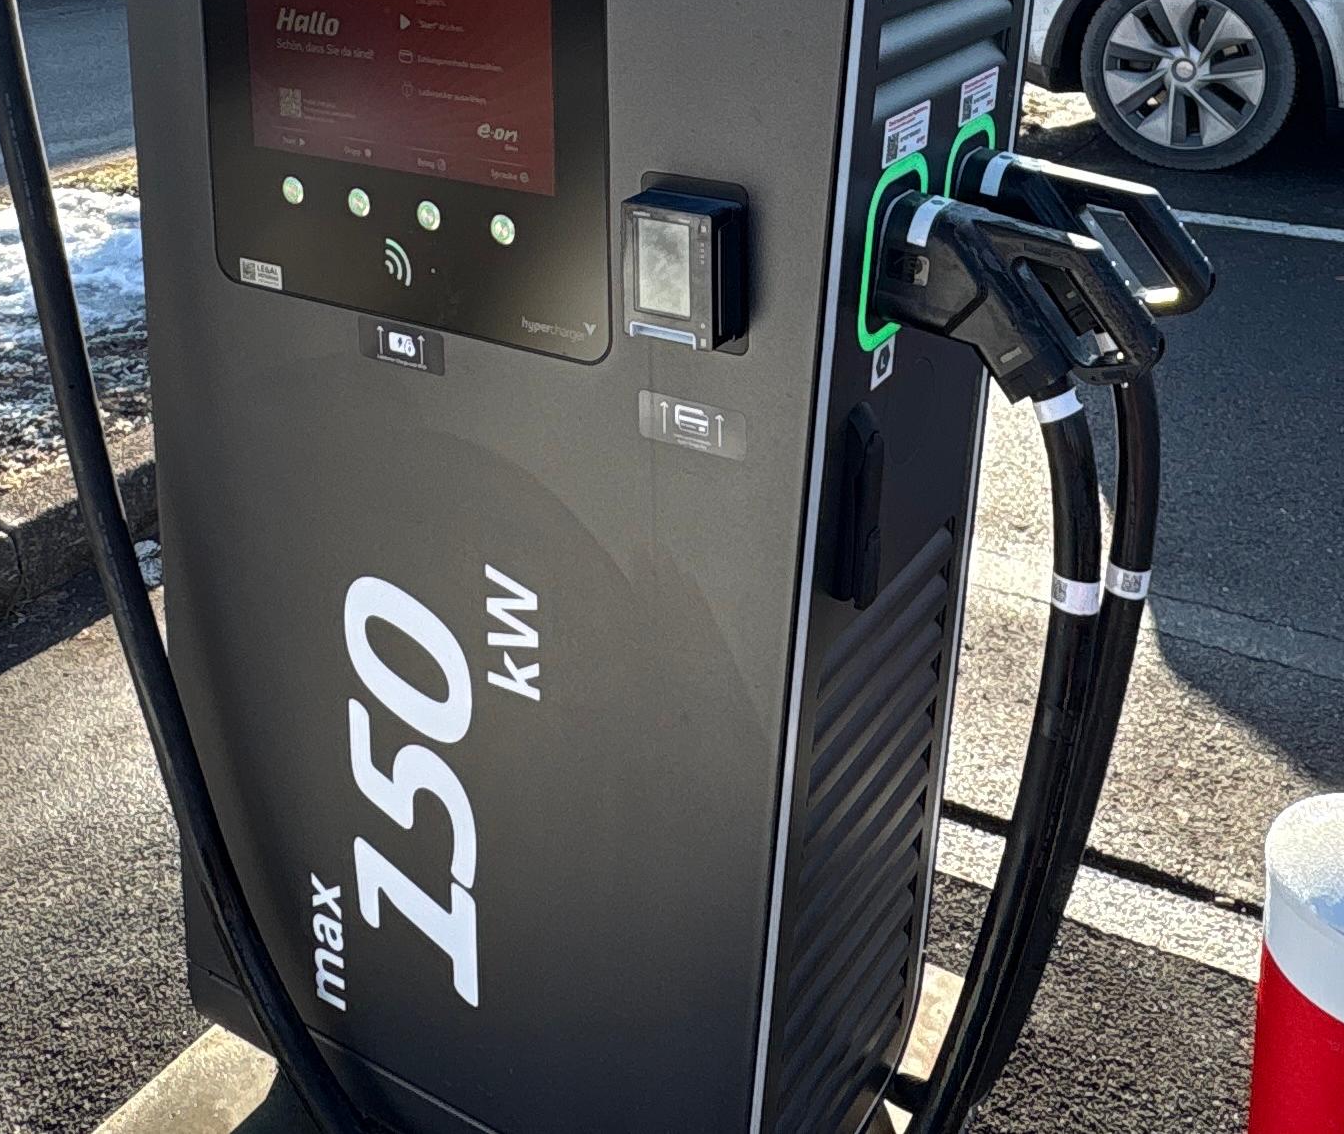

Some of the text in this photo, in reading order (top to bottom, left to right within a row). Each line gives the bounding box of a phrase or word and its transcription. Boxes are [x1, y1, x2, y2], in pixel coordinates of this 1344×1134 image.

[276, 7, 340, 36] Hallo
[276, 38, 306, 52] Schön,
[326, 43, 339, 56] Sie
[521, 316, 585, 343] hypercharger
[484, 563, 541, 702] kW
[344, 576, 479, 1008] 150
[310, 872, 347, 1012] max
